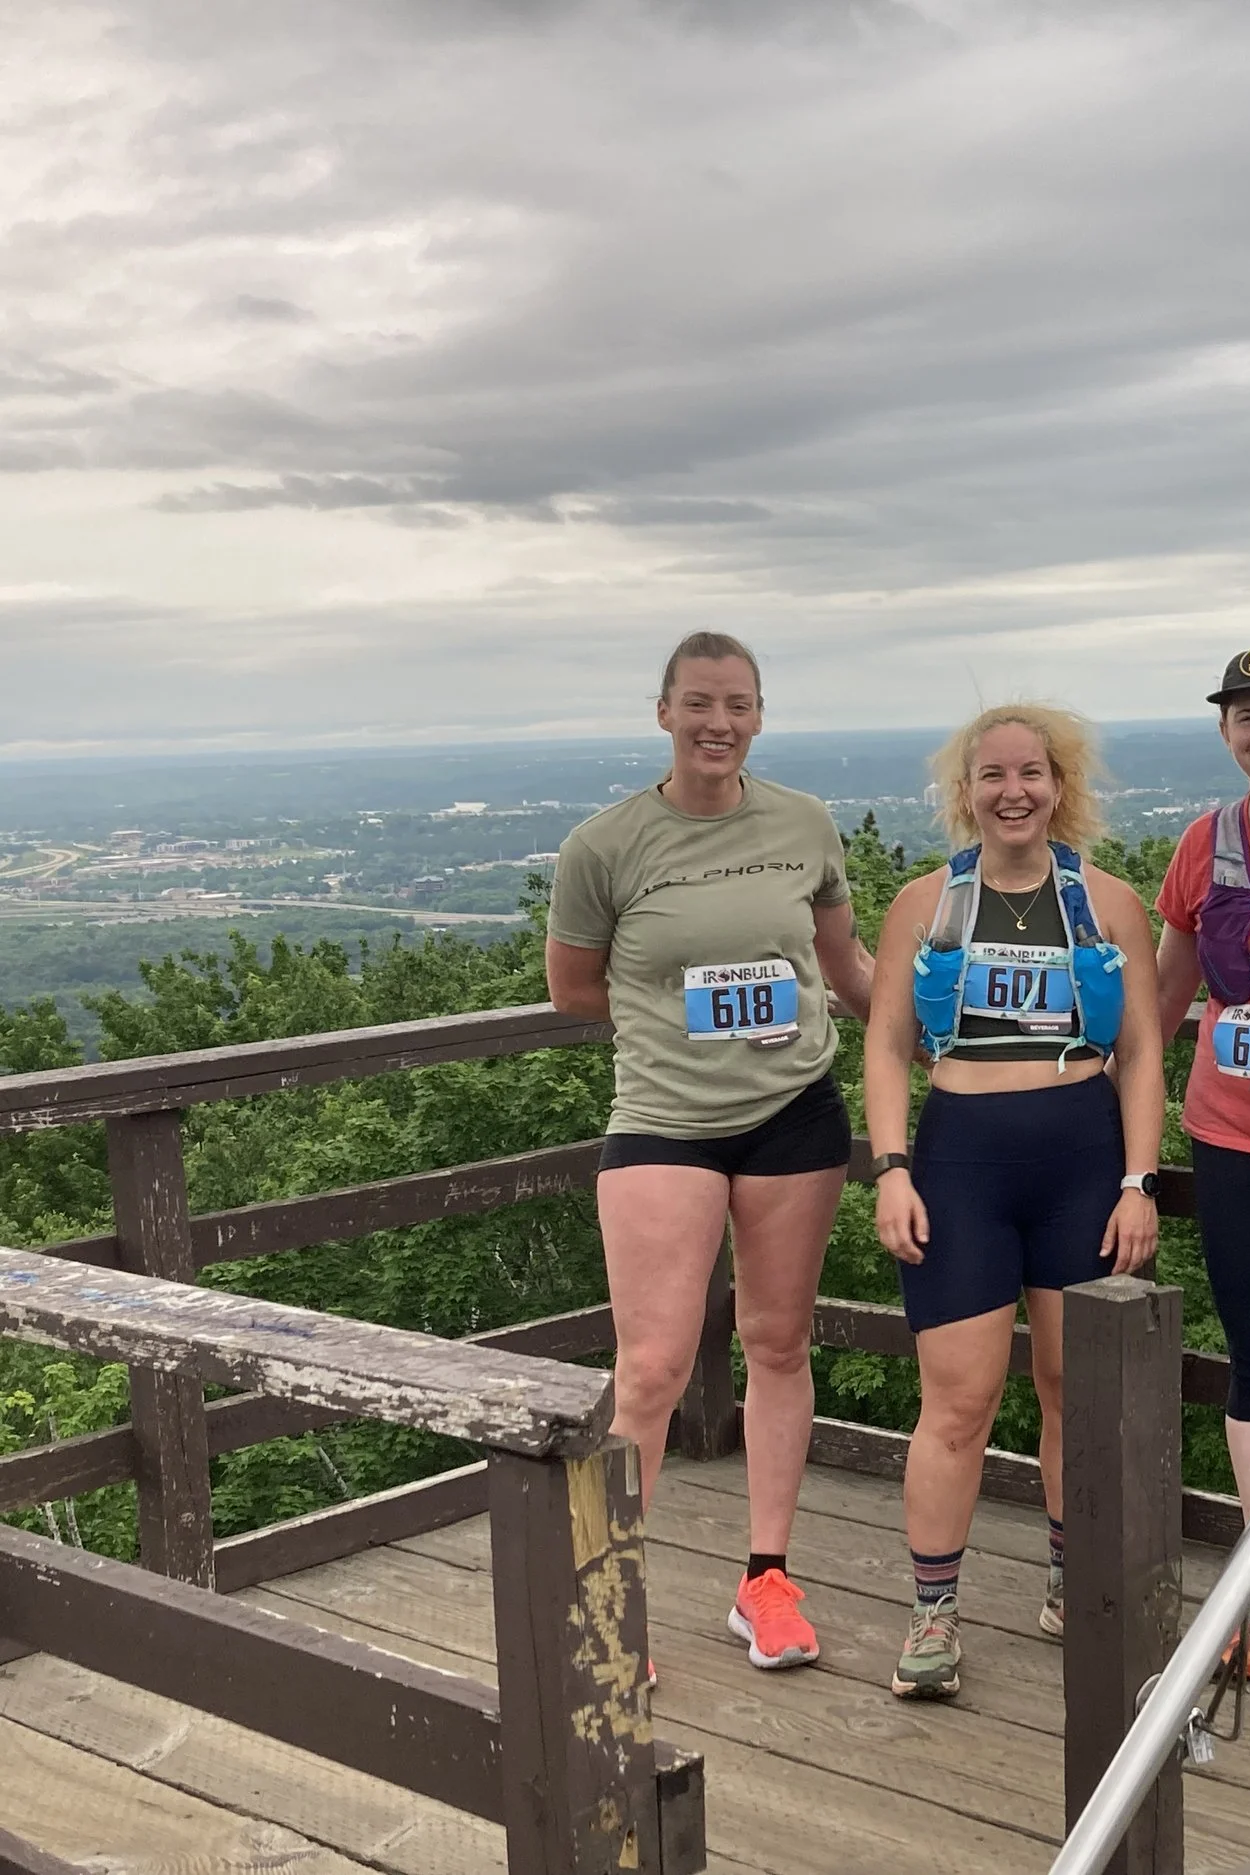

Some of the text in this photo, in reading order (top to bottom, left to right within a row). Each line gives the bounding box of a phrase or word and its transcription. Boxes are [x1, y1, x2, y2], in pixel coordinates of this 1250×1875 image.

[703, 862, 804, 879] PHORM
[703, 964, 780, 984] IRONBULL
[987, 967, 1048, 1010] 601
[711, 984, 775, 1029] 618
